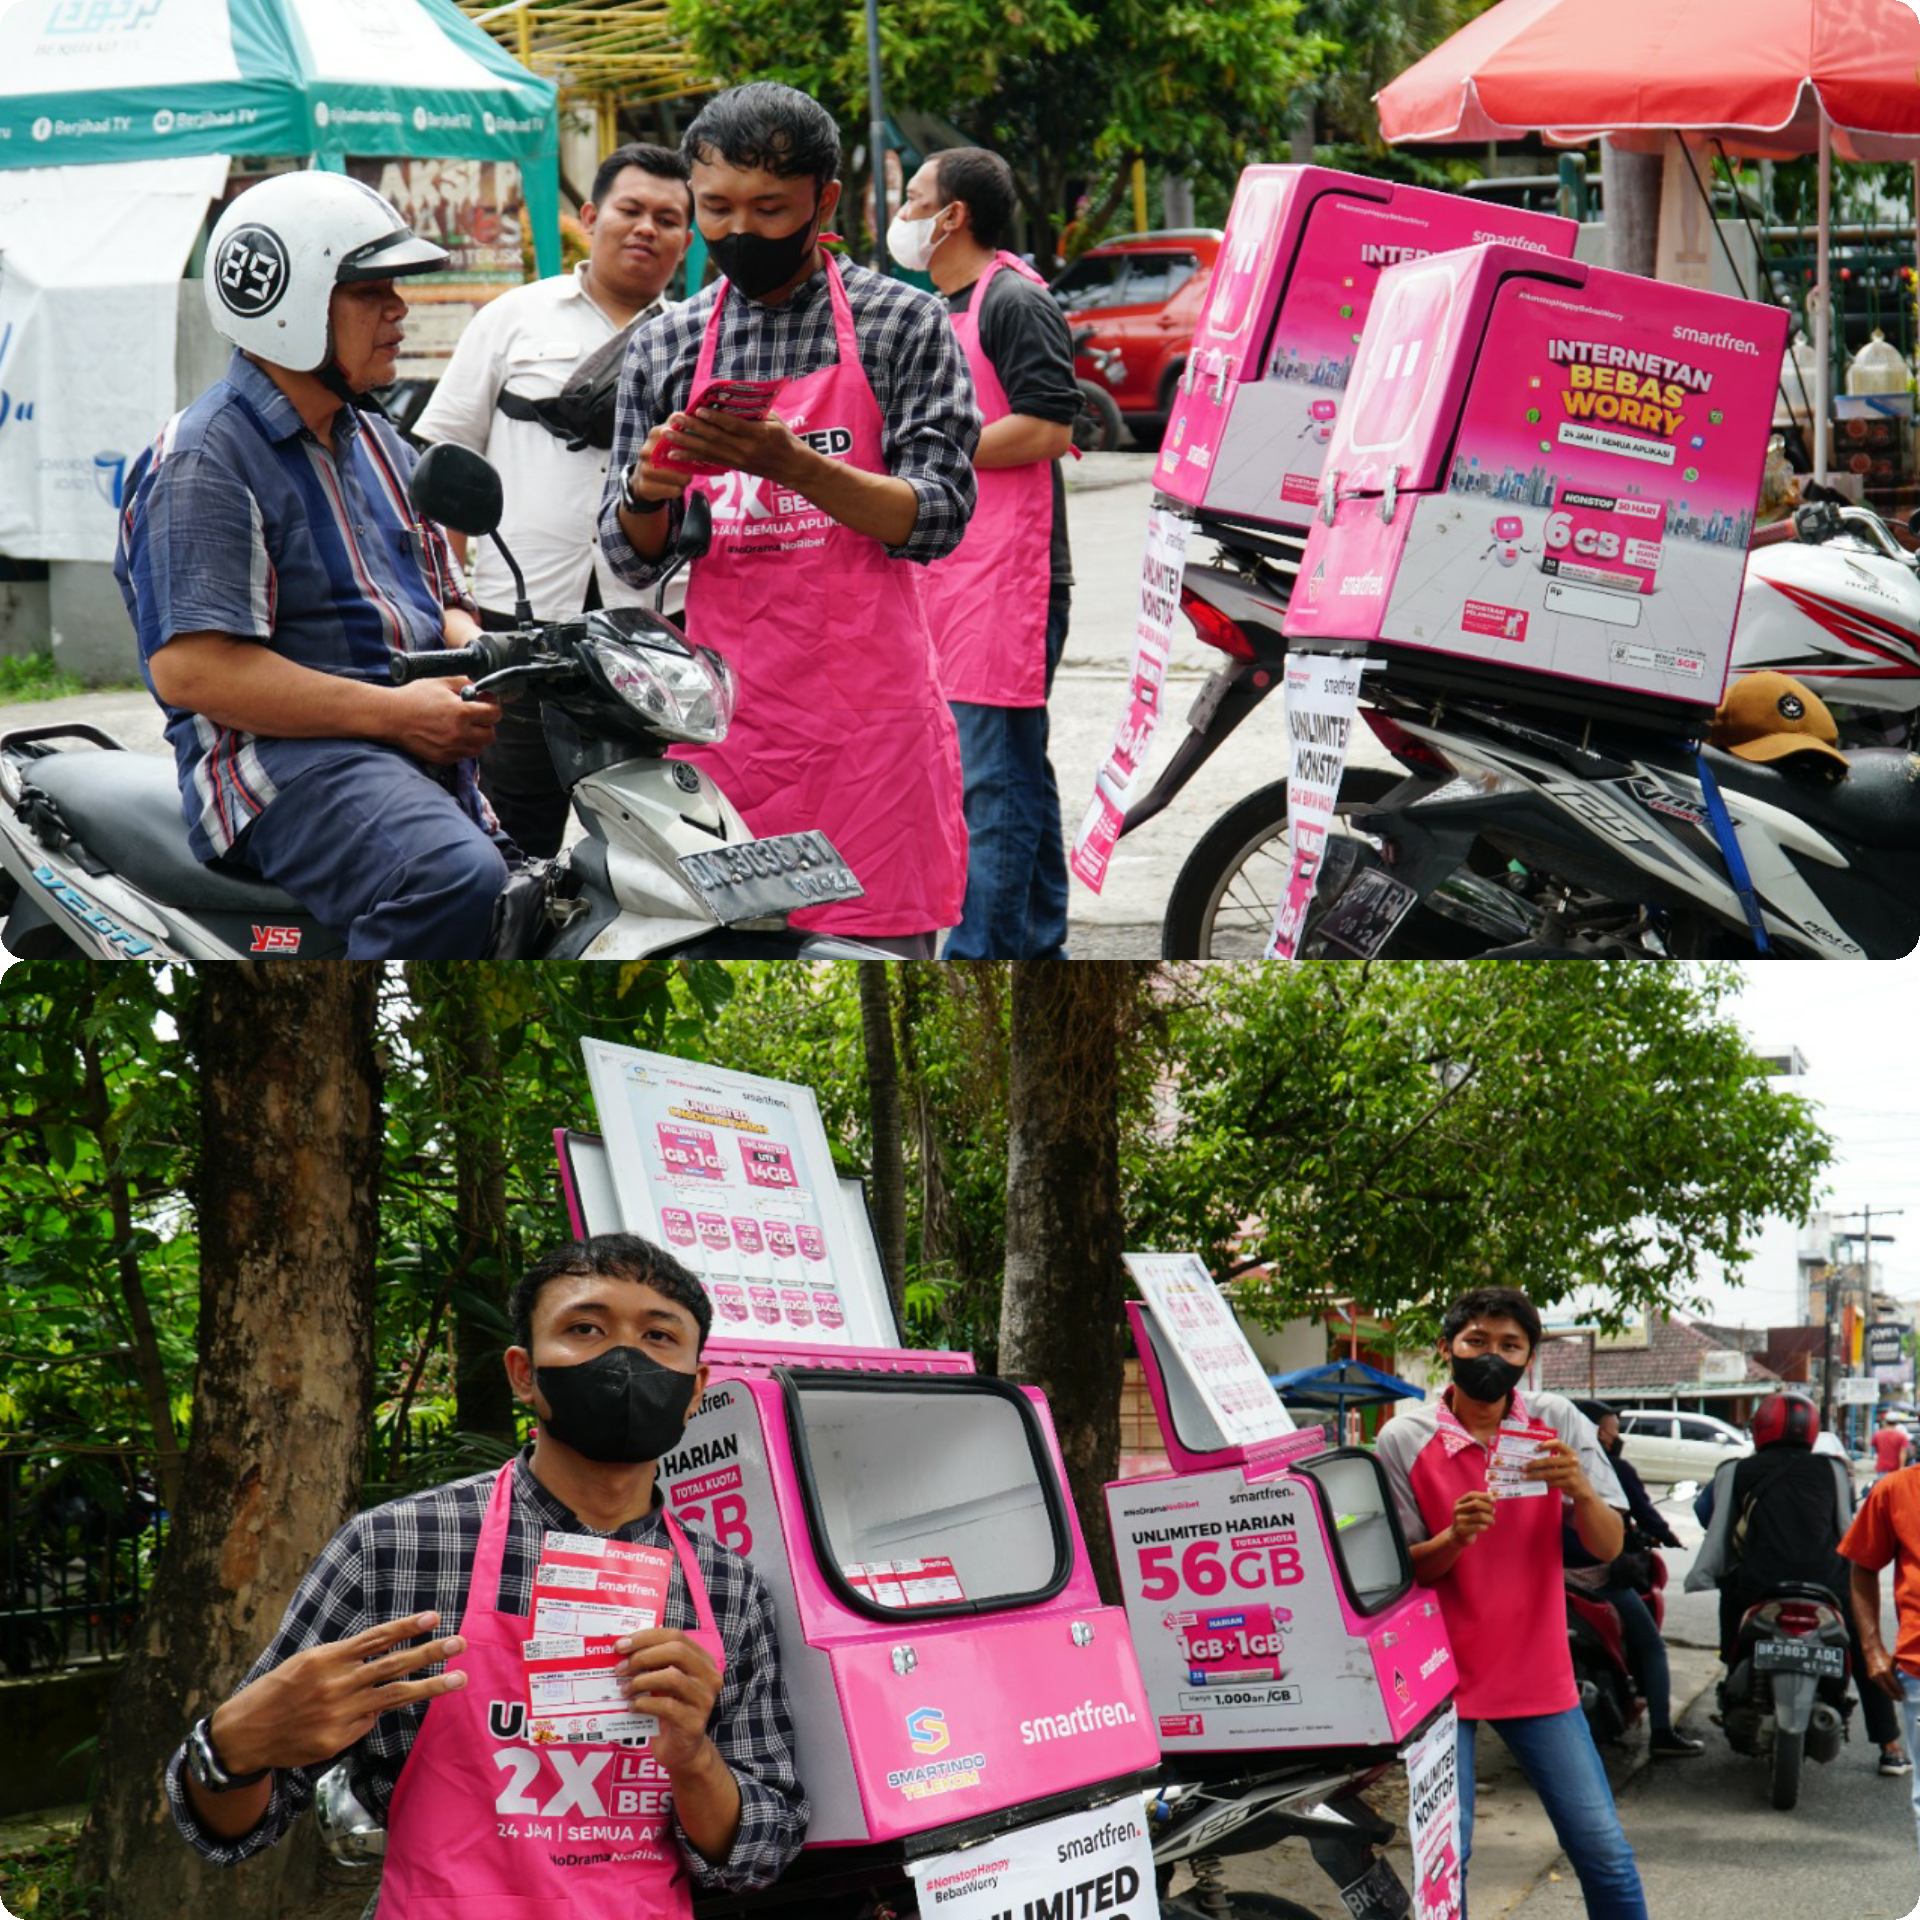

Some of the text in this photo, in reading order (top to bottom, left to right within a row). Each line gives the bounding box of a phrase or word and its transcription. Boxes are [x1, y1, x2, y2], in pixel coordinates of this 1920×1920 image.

[54, 116, 131, 137] Berjihad TV
[176, 109, 258, 128] Berjihad TV
[1673, 325, 1759, 357] smartfren.
[1548, 339, 1714, 393] INTERNETAN
[1570, 364, 1686, 408] BEBAS
[1561, 390, 1687, 437] WORRY
[1601, 437, 1630, 451] SEMUA
[1631, 443, 1671, 459] APLIKASI
[709, 470, 773, 520] 2X
[1565, 493, 1614, 509] NONSTOP
[743, 521, 794, 537] SEMUA
[1550, 586, 1563, 596] Rp
[1649, 800, 1705, 823] TECHNO
[684, 1099, 750, 1121] UNLIMITED
[659, 1124, 711, 1141] UNLIMITED
[748, 1163, 792, 1183] 14GB
[663, 1433, 738, 1477] HARIAN
[675, 1470, 738, 1500] TOTAL KUOTA
[1229, 1487, 1295, 1504] smartfren.
[1132, 1513, 1295, 1545] UNLIMITED HARIAN
[1235, 1535, 1294, 1548] TOTAL KUOTA
[606, 1548, 667, 1567] smartfren.
[1137, 1540, 1305, 1601] 56GB
[598, 1581, 659, 1597] smartfren.
[1209, 1616, 1243, 1628] HARIAN
[1020, 1699, 1136, 1745] smartfren.
[888, 1754, 986, 1787] SMARTINDO
[493, 1747, 614, 1819] 2X
[902, 1771, 979, 1801] TELEKOM
[497, 1823, 519, 1838] 24
[567, 1826, 633, 1841] SEMUA
[926, 1821, 1142, 1892] #NonstopHappy smartfren.
[935, 1876, 999, 1904] BebasWorry
